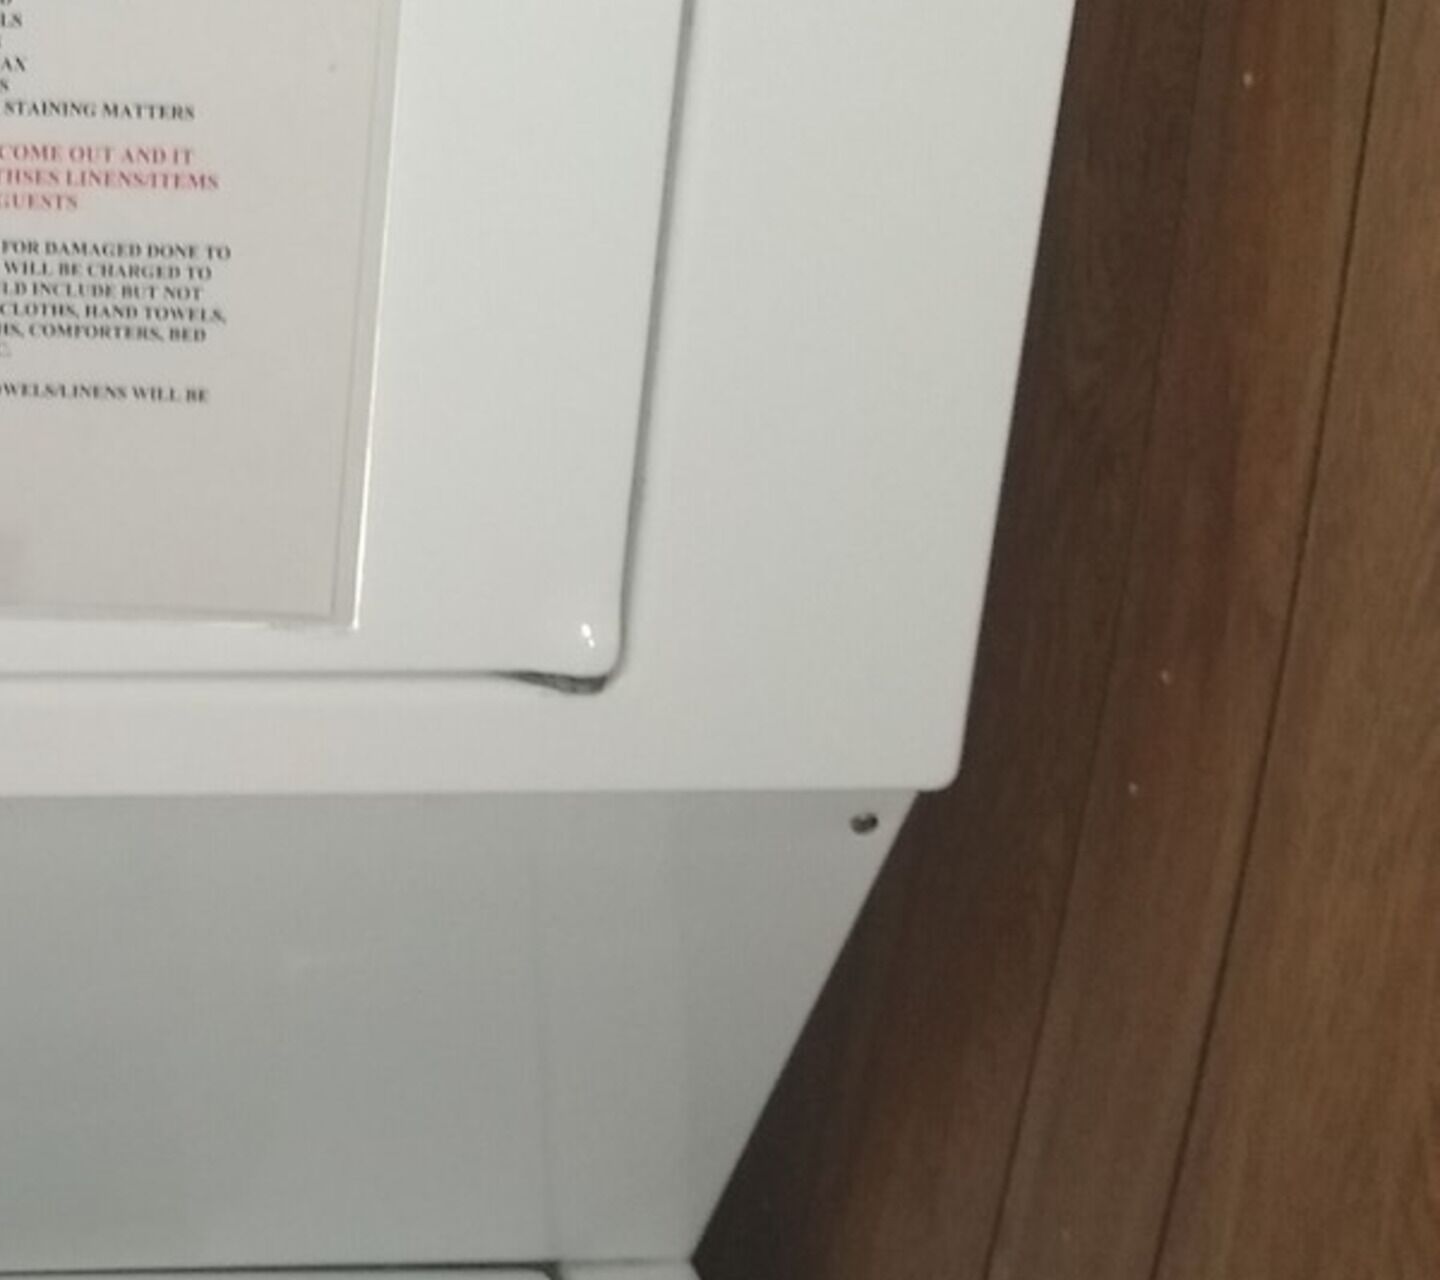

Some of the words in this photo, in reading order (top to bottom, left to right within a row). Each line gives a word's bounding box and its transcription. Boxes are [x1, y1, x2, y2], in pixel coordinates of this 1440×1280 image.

[4, 99, 96, 117] STAINING
[103, 102, 194, 120] MATTERS
[69, 145, 114, 164] OUT
[122, 147, 166, 164] AND
[173, 147, 193, 166] IT
[2, 239, 39, 255] FOR
[45, 241, 142, 259] DAMAGED
[147, 243, 198, 259] DONE
[206, 245, 231, 261] TO
[4, 260, 52, 276] WILL
[58, 261, 81, 277] BE
[86, 262, 181, 280] CHARGED
[187, 265, 212, 281] TO
[32, 281, 115, 299] INCLUDE
[121, 283, 158, 300] BUT
[163, 285, 203, 301] NOT
[85, 304, 138, 320] HAND
[144, 305, 226, 323] TOWELS,
[169, 326, 206, 342] BED
[132, 386, 179, 402] WILL
[186, 388, 208, 403] BE
